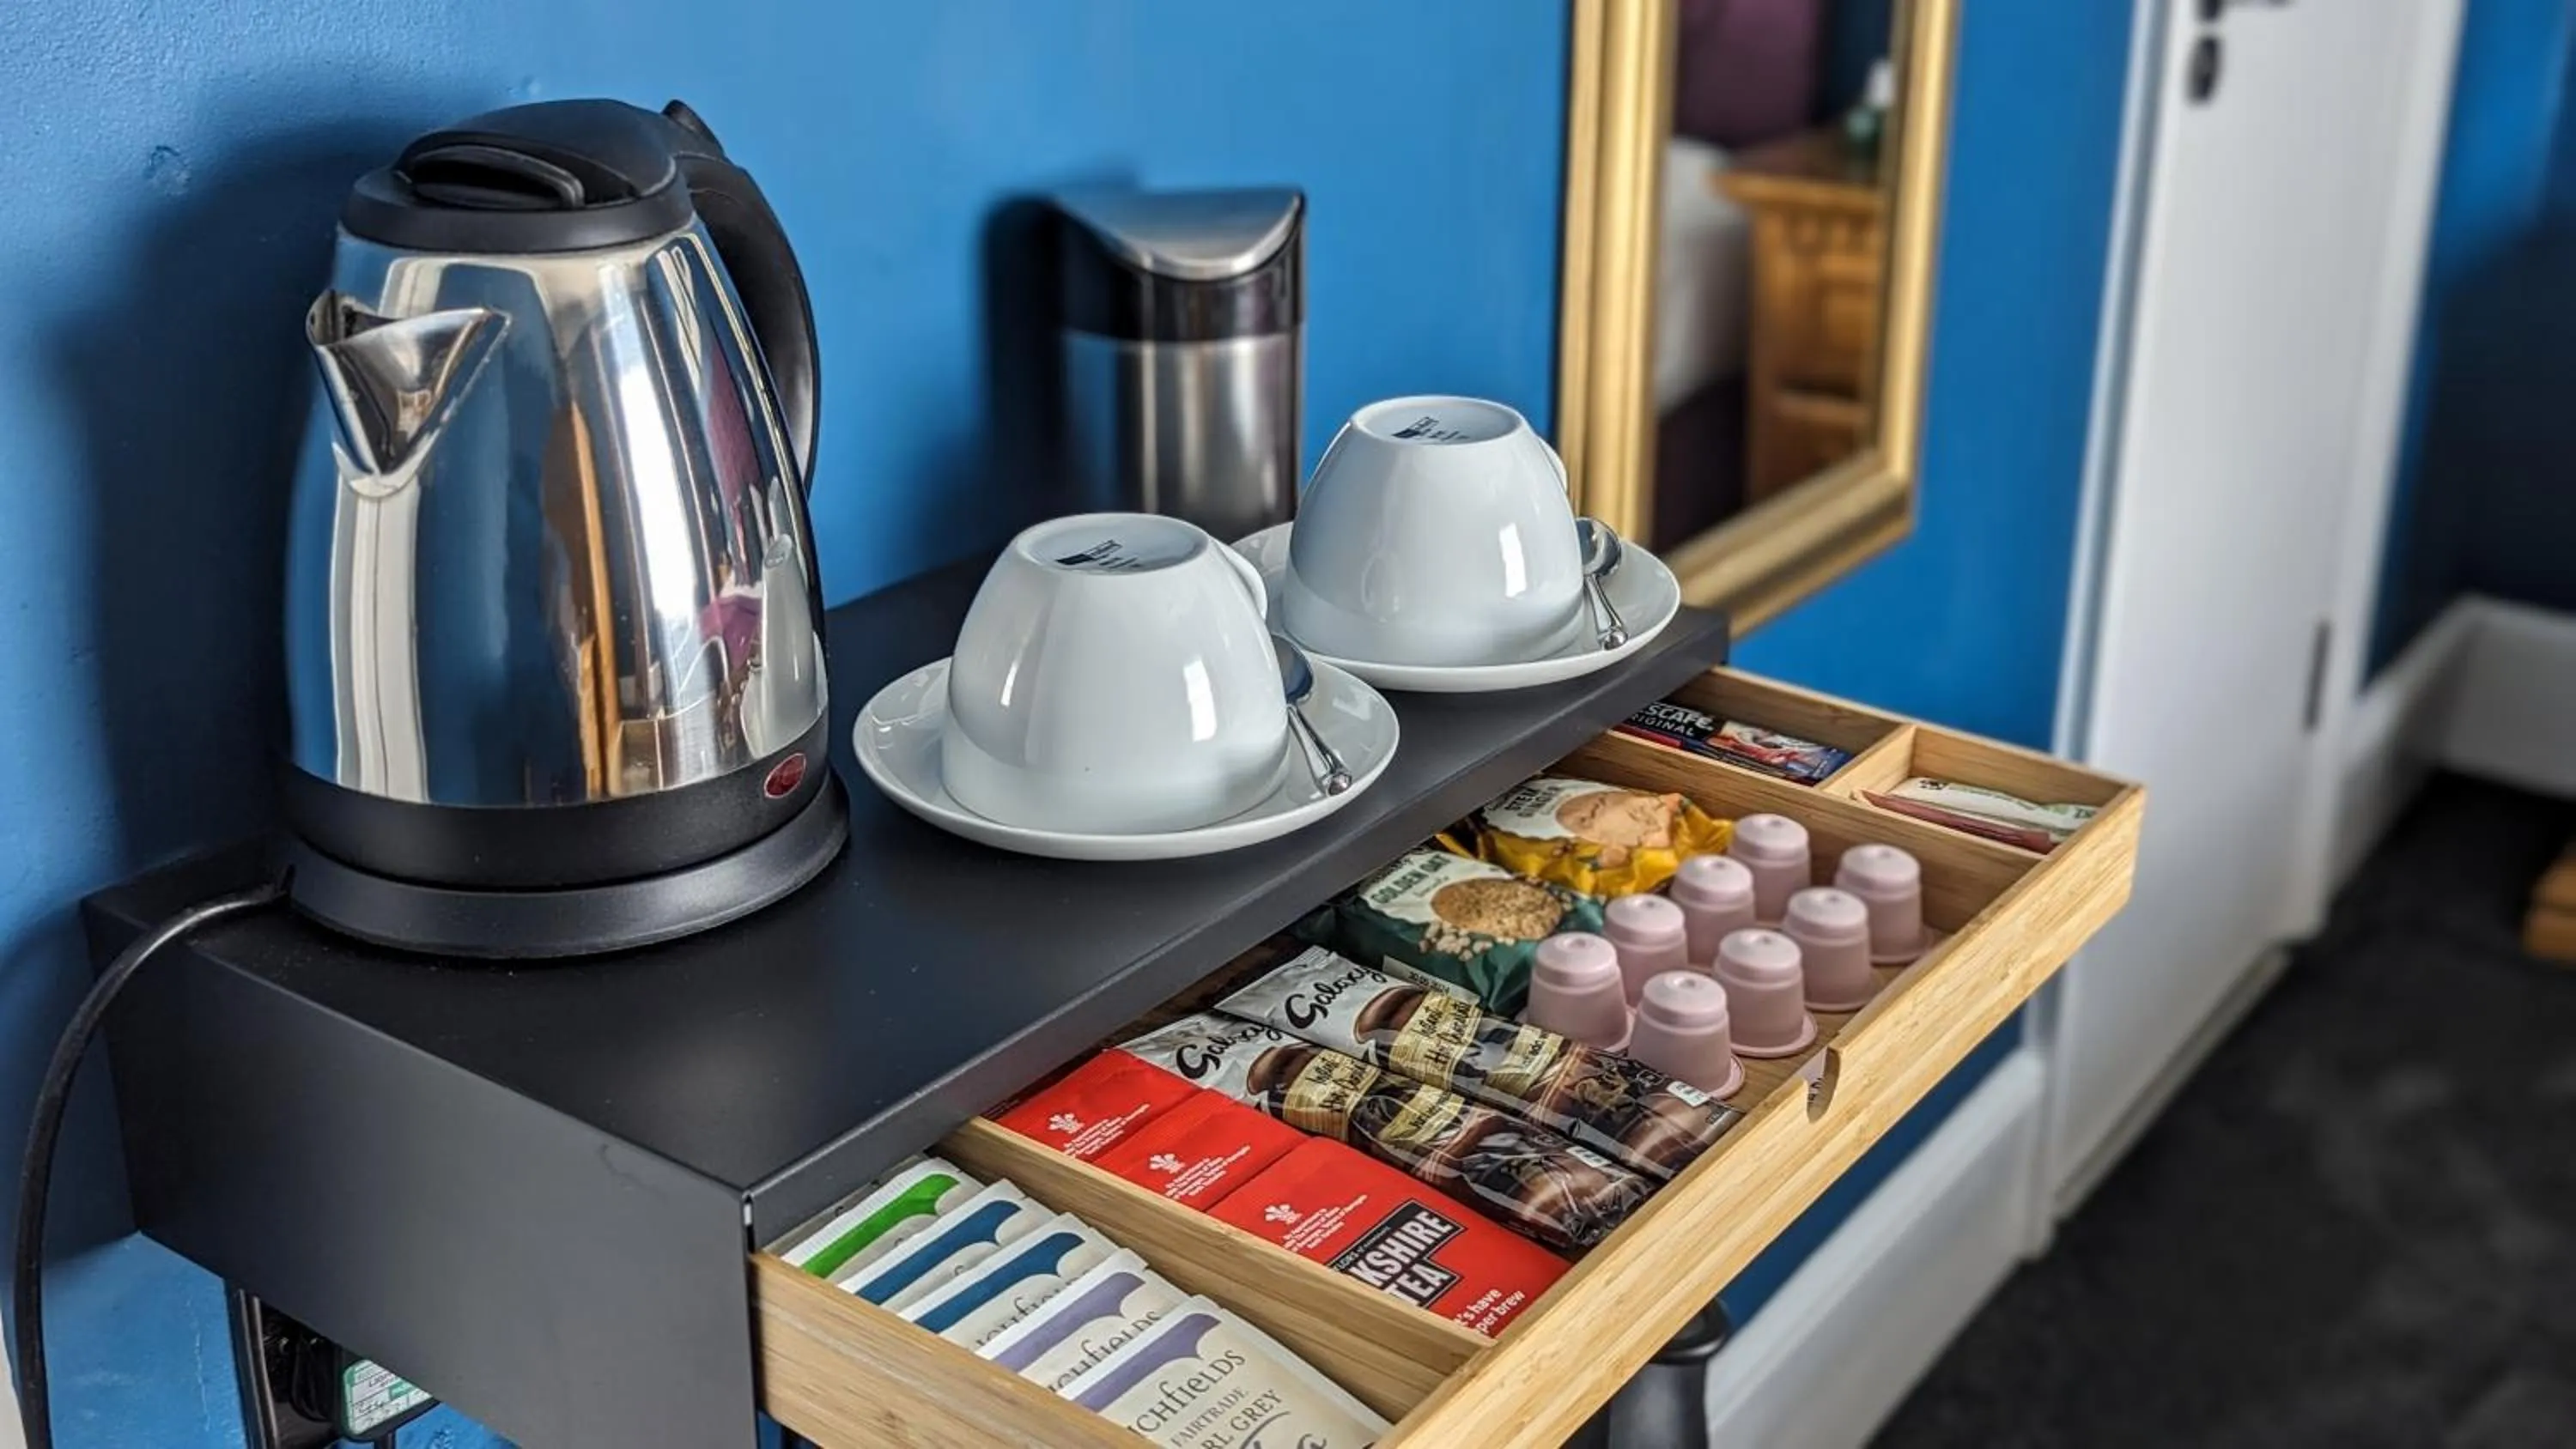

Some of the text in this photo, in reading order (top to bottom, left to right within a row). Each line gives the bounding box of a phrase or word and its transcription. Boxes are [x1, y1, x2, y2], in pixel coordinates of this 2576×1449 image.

[1370, 868, 1430, 904] GOLDEN
[1419, 853, 1452, 873] OAT
[1285, 965, 1388, 1029] Galaxy
[1176, 1023, 1283, 1080] Galaxy
[1348, 1210, 1454, 1288] KSHIRE
[1384, 1262, 1452, 1307] TEA
[1468, 1288, 1503, 1315] have
[1474, 1289, 1527, 1334] per brew
[1170, 1386, 1249, 1448] FAIRTRADE
[1230, 1387, 1283, 1431] GREY
